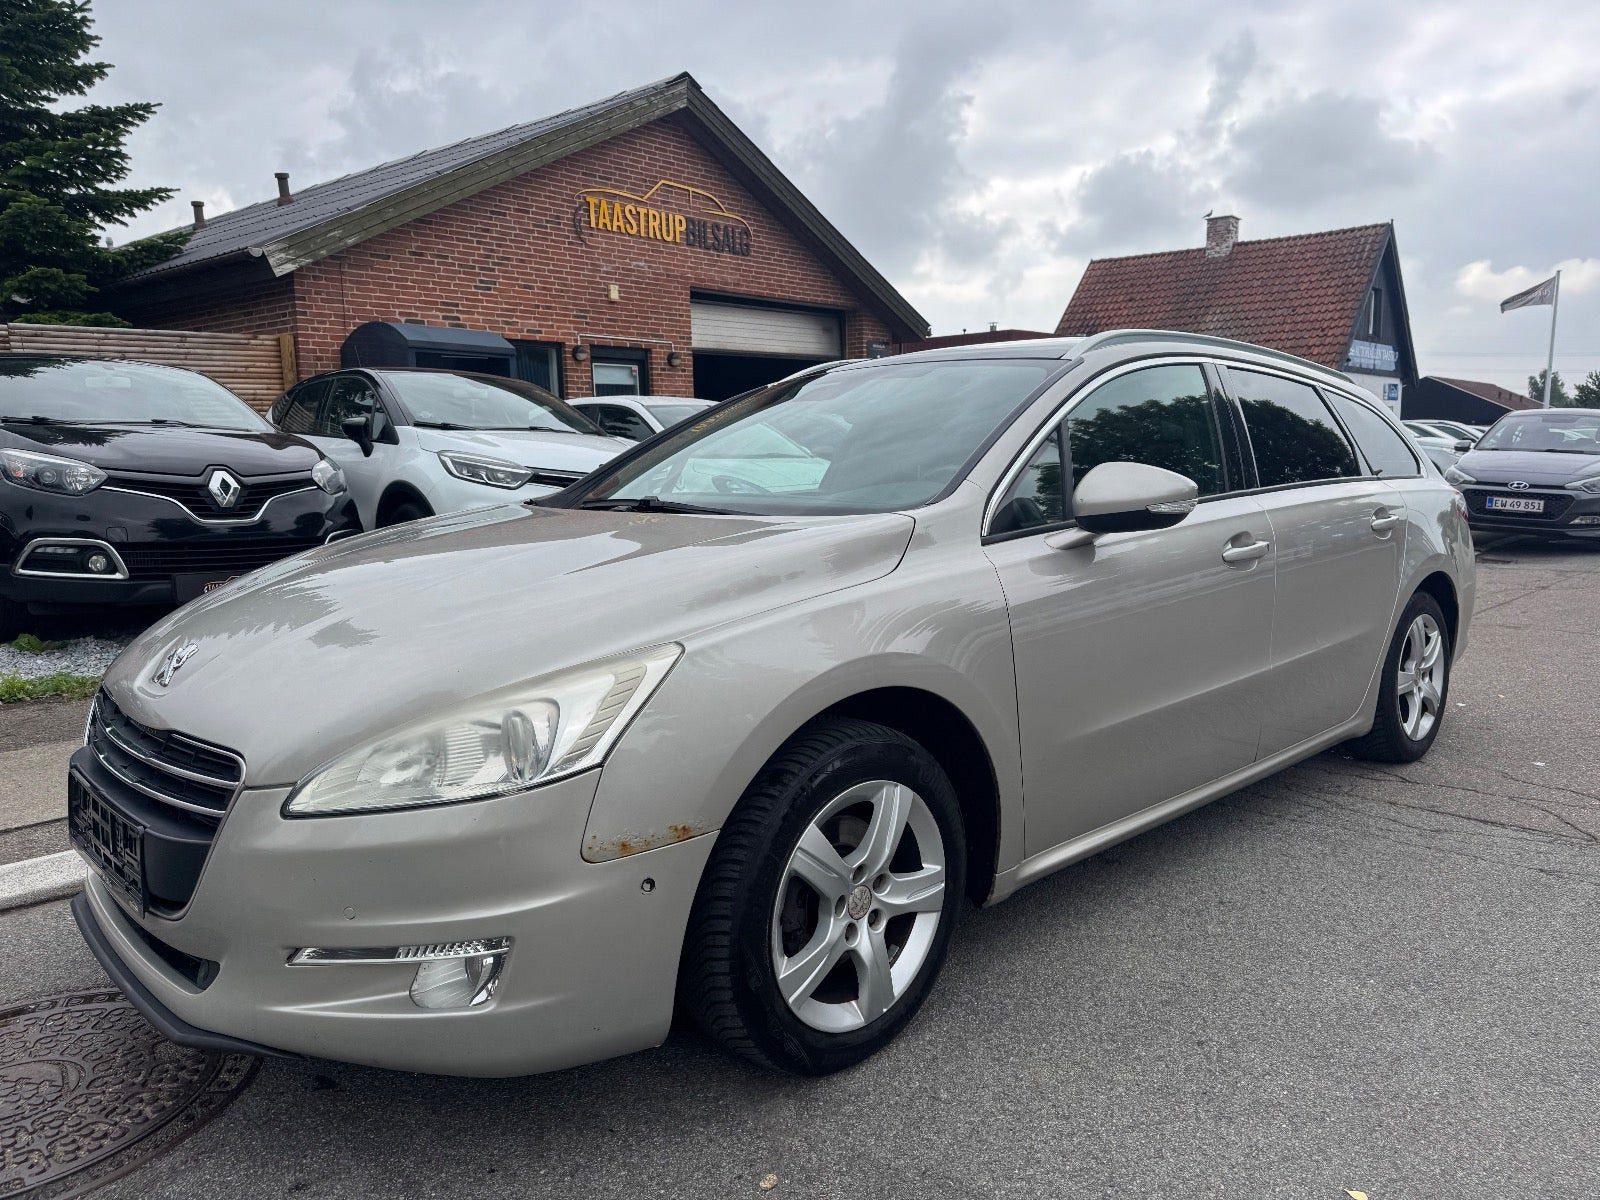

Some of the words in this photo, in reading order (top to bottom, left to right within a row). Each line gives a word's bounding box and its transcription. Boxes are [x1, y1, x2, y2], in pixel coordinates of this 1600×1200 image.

[1494, 499, 1508, 508] EW
[1509, 500, 1521, 509] 49
[1523, 501, 1542, 511] 851
